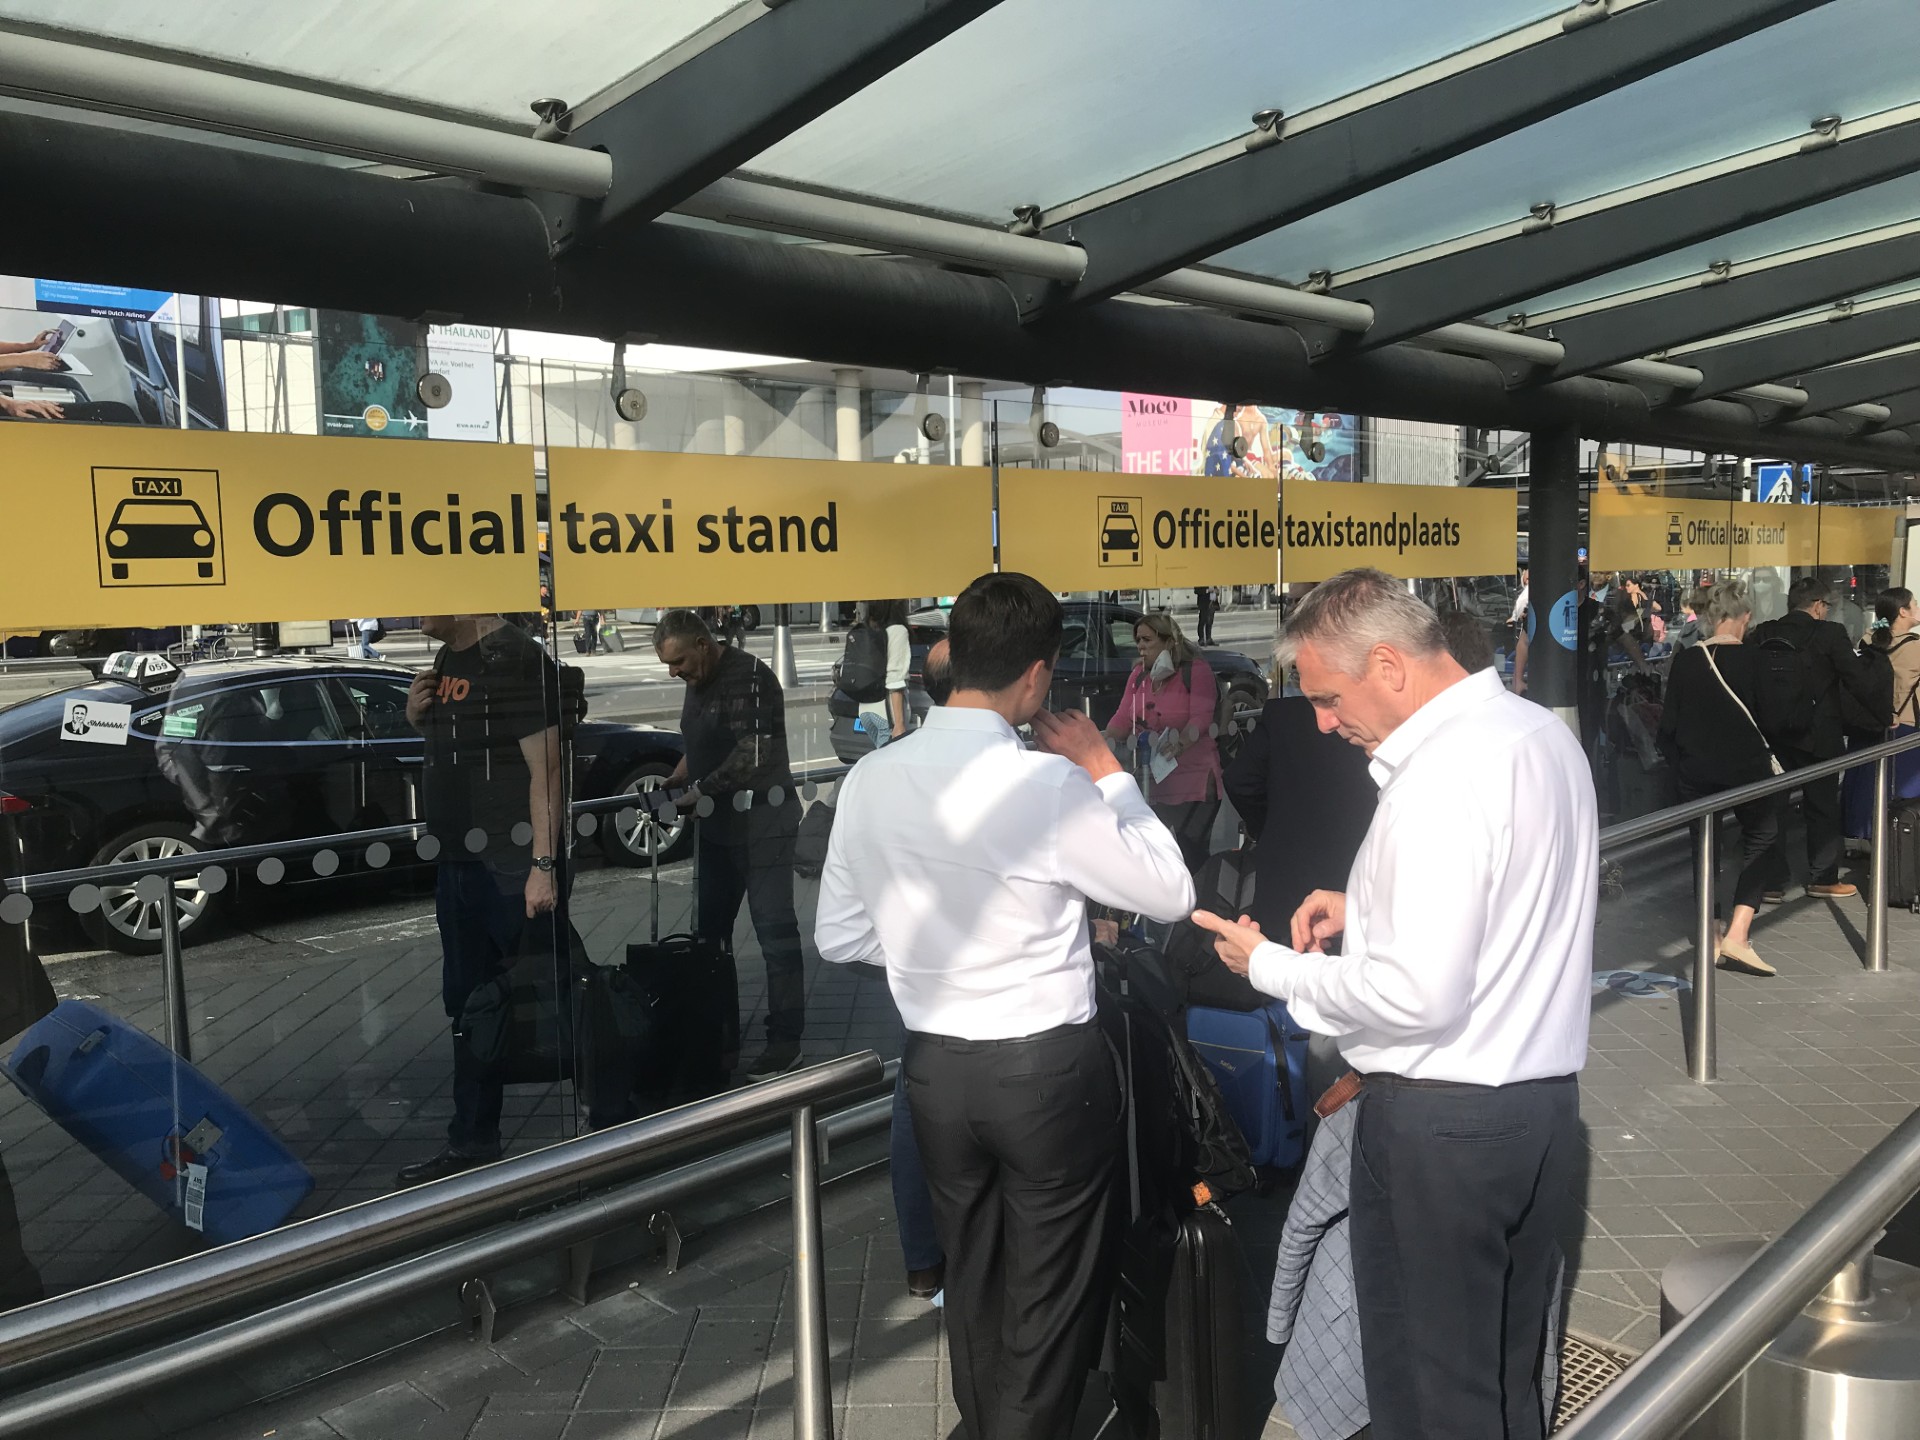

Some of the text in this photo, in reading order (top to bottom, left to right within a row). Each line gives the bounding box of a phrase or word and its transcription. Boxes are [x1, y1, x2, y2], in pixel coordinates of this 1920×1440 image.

[91, 308, 107, 316] Royal
[126, 311, 146, 319] Airlines
[440, 325, 491, 340] THAILAND
[1128, 399, 1177, 417] Moco
[1126, 450, 1162, 473] THE
[134, 480, 178, 494] TAXI
[1112, 503, 1128, 512] TAXI
[254, 489, 838, 557] Official taxi stand
[1153, 507, 1460, 555] Officiële taxistandplaats
[1687, 519, 1785, 545] Official taxi stand
[149, 662, 168, 672] 059
